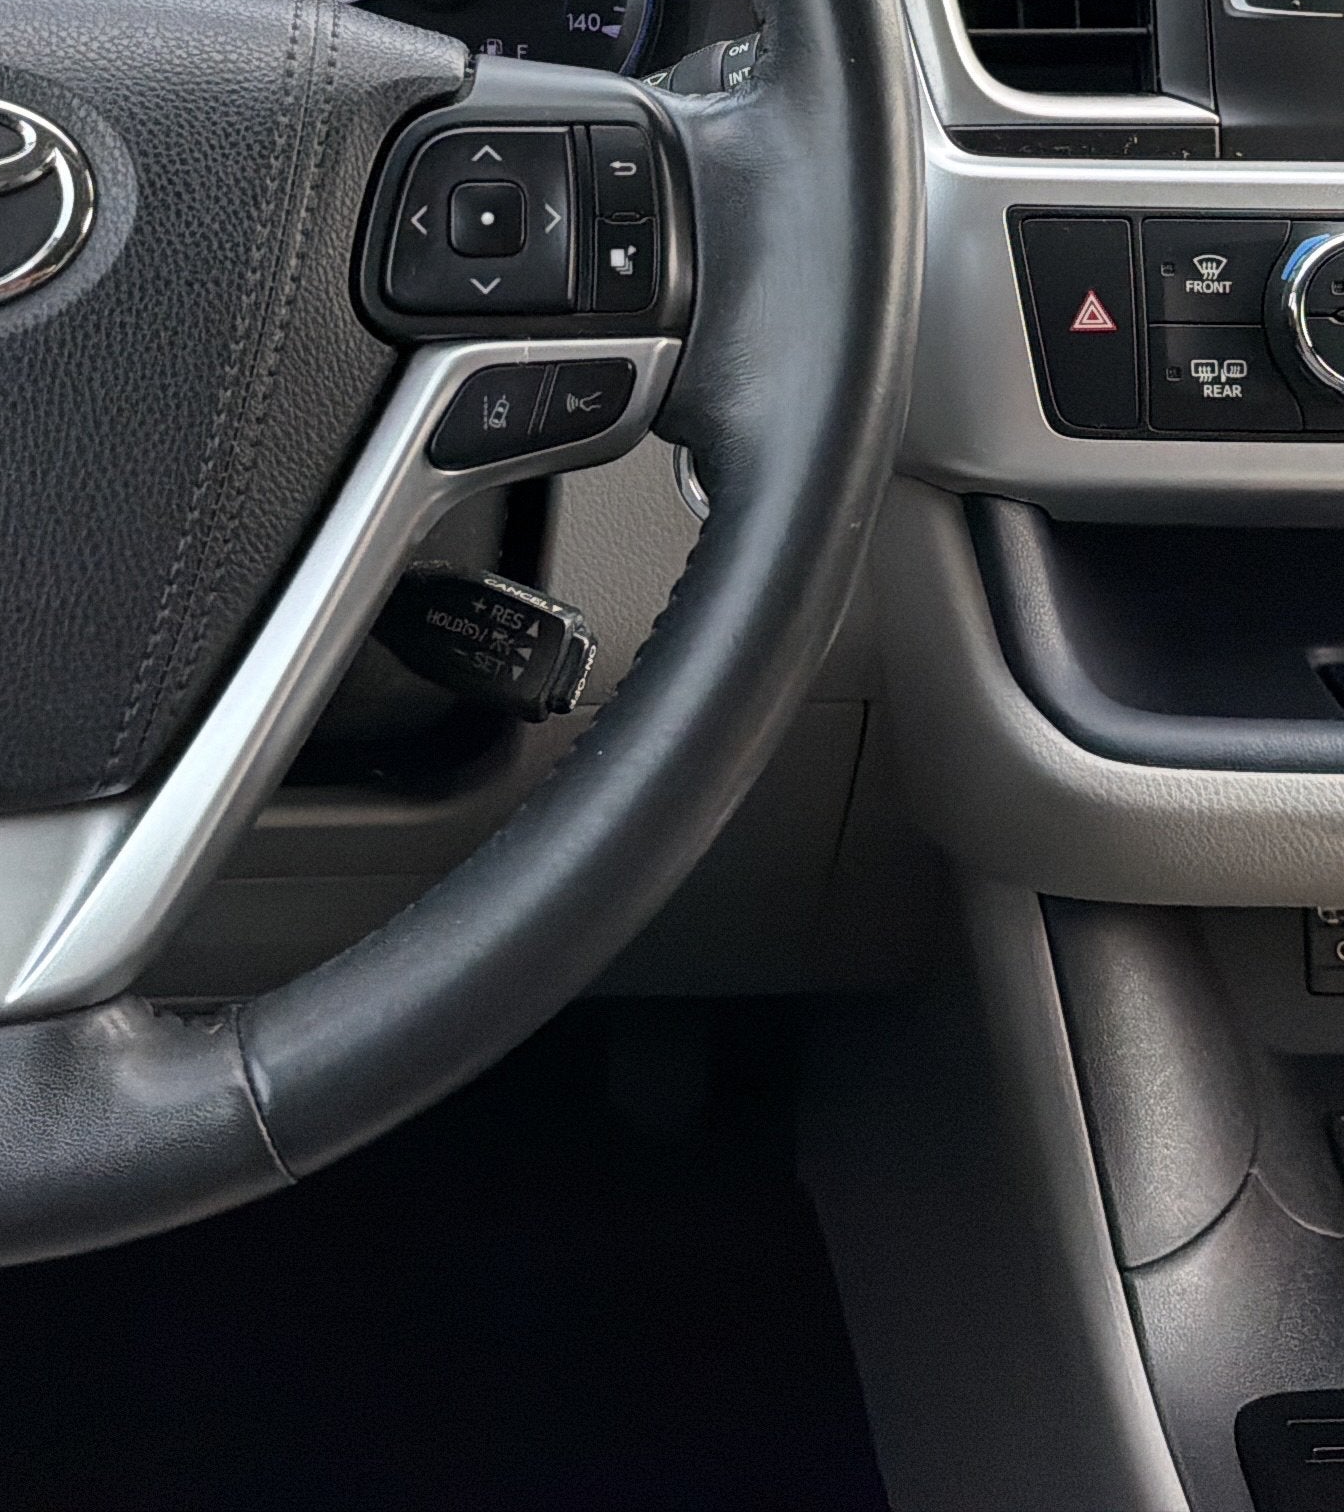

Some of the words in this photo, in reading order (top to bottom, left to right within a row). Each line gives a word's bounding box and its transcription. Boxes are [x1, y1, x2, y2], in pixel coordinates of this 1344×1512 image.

[567, 13, 601, 32] 140
[517, 44, 528, 60] F
[728, 42, 750, 56] ON
[728, 67, 751, 86] INT
[1185, 281, 1232, 294] FRONT
[1203, 384, 1242, 398] REAR
[483, 578, 549, 610] CANCEL
[490, 604, 525, 630] RES
